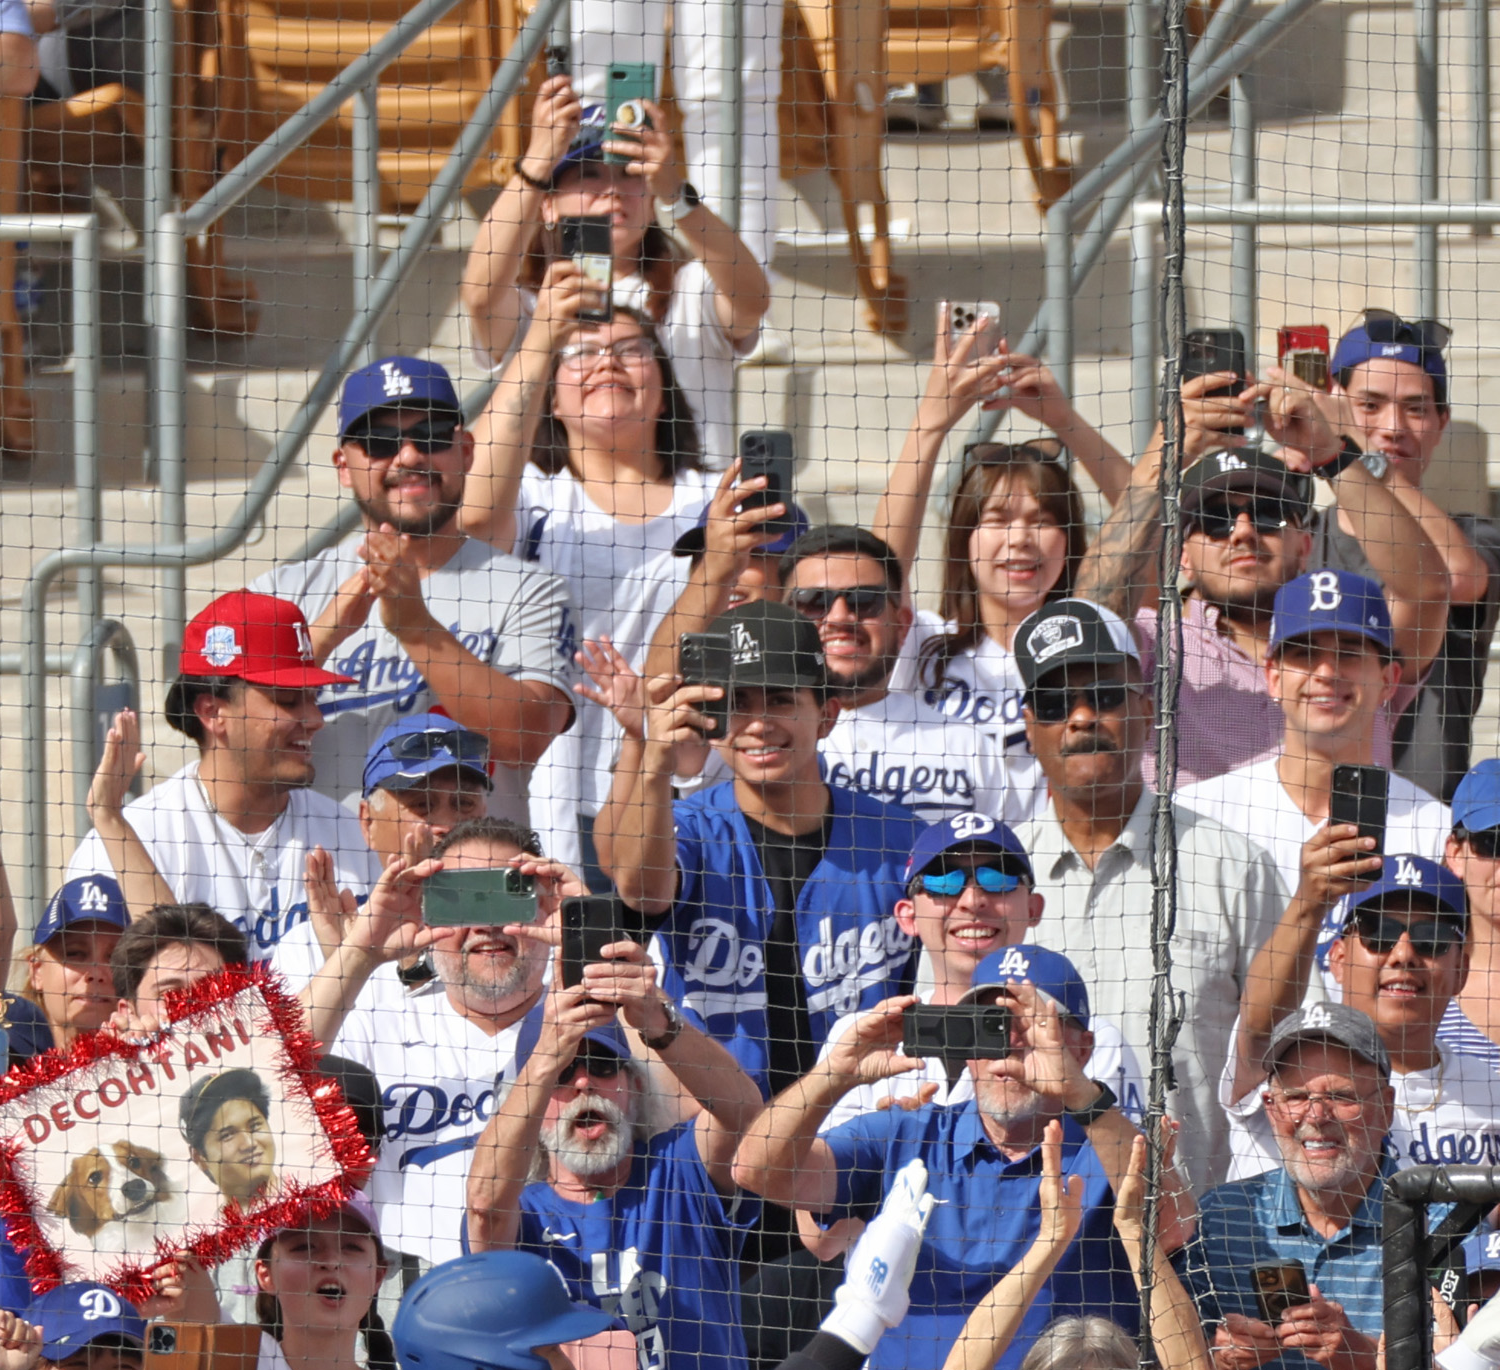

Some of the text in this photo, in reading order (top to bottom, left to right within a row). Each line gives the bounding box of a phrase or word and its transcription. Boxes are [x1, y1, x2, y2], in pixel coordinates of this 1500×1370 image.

[380, 362, 413, 398] LA
[1310, 572, 1342, 611] B
[950, 811, 995, 839] D
[1394, 856, 1422, 888] LA
[79, 882, 108, 912] LA
[998, 947, 1030, 977] LA
[1301, 1005, 1331, 1029] LA
[24, 1019, 254, 1145] DECOHTANI
[79, 1288, 122, 1320] D
